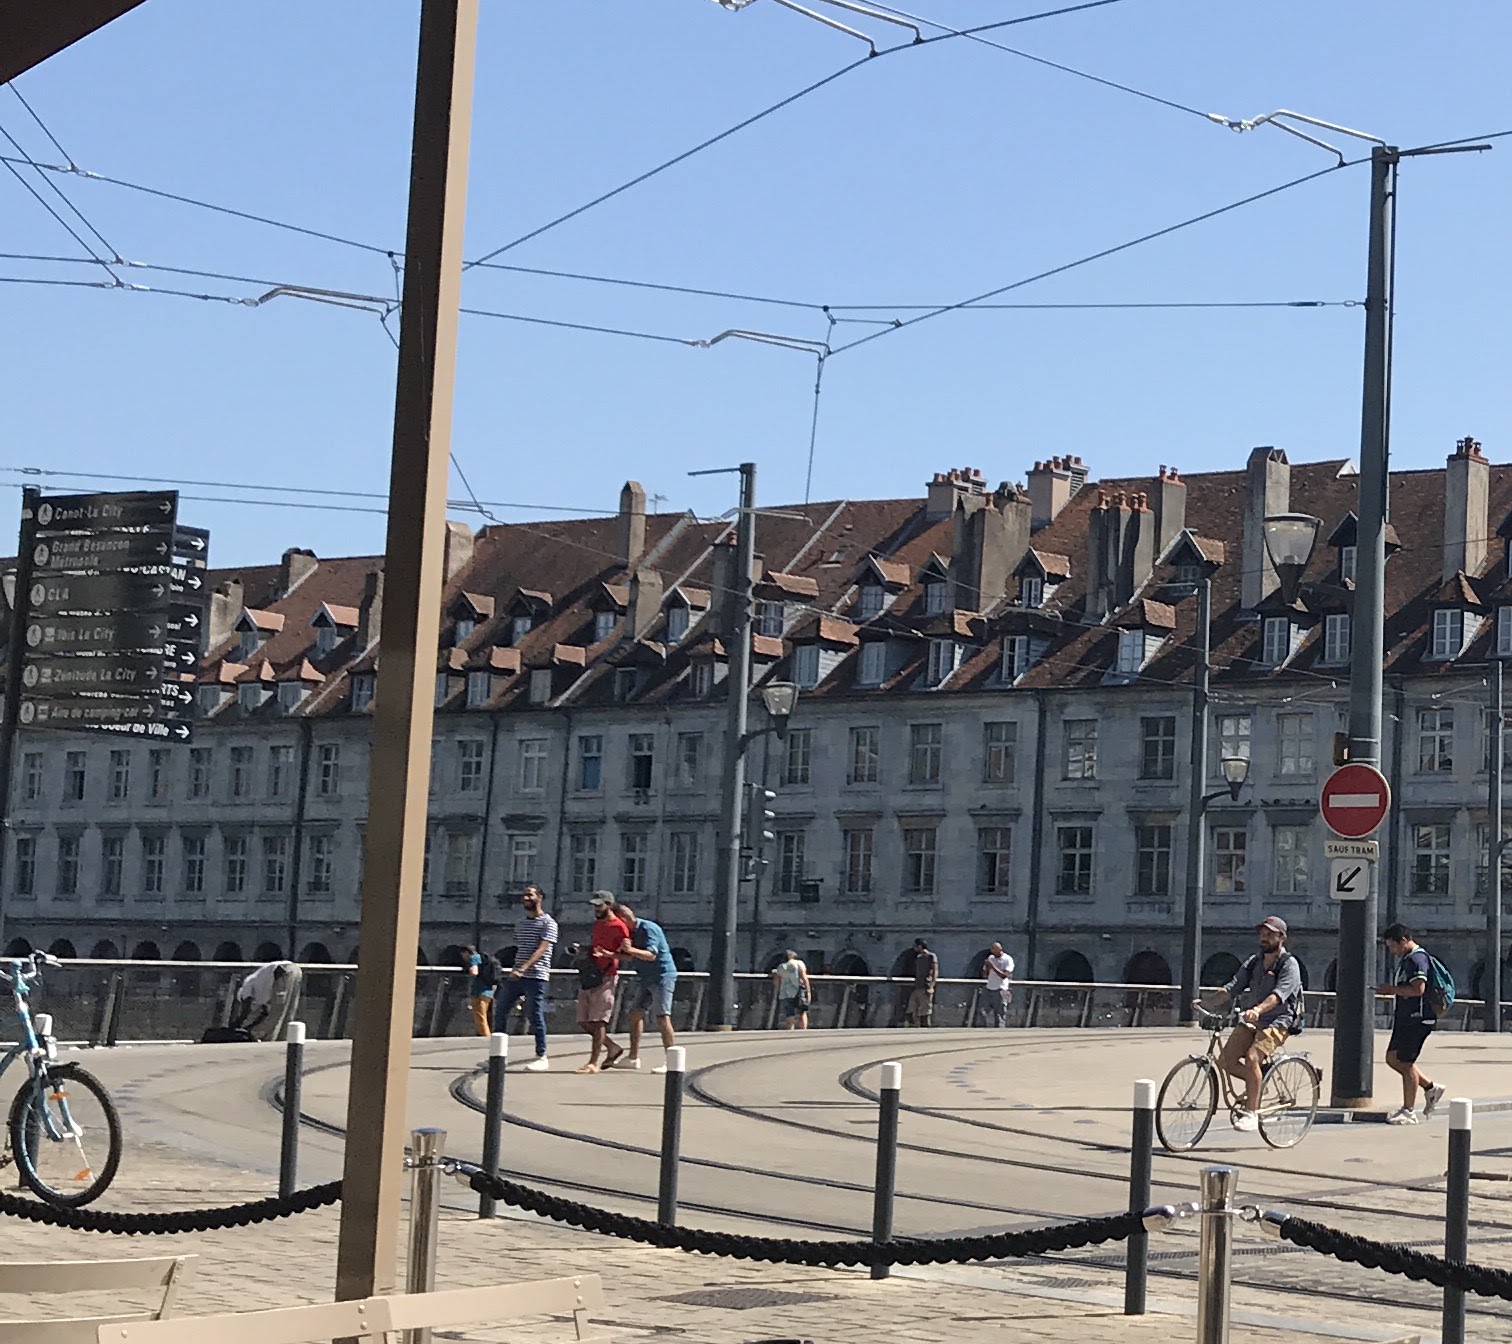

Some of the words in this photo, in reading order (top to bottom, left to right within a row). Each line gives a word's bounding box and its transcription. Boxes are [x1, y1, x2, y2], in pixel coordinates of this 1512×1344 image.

[102, 504, 124, 519] City
[52, 540, 81, 553] Grand
[78, 628, 91, 640] La
[94, 627, 116, 642] City
[100, 668, 112, 681] La
[115, 667, 137, 682] City
[70, 707, 83, 718] de
[148, 723, 170, 737] Ville
[1328, 844, 1349, 854] SAUF
[1350, 846, 1374, 855] TRAM
